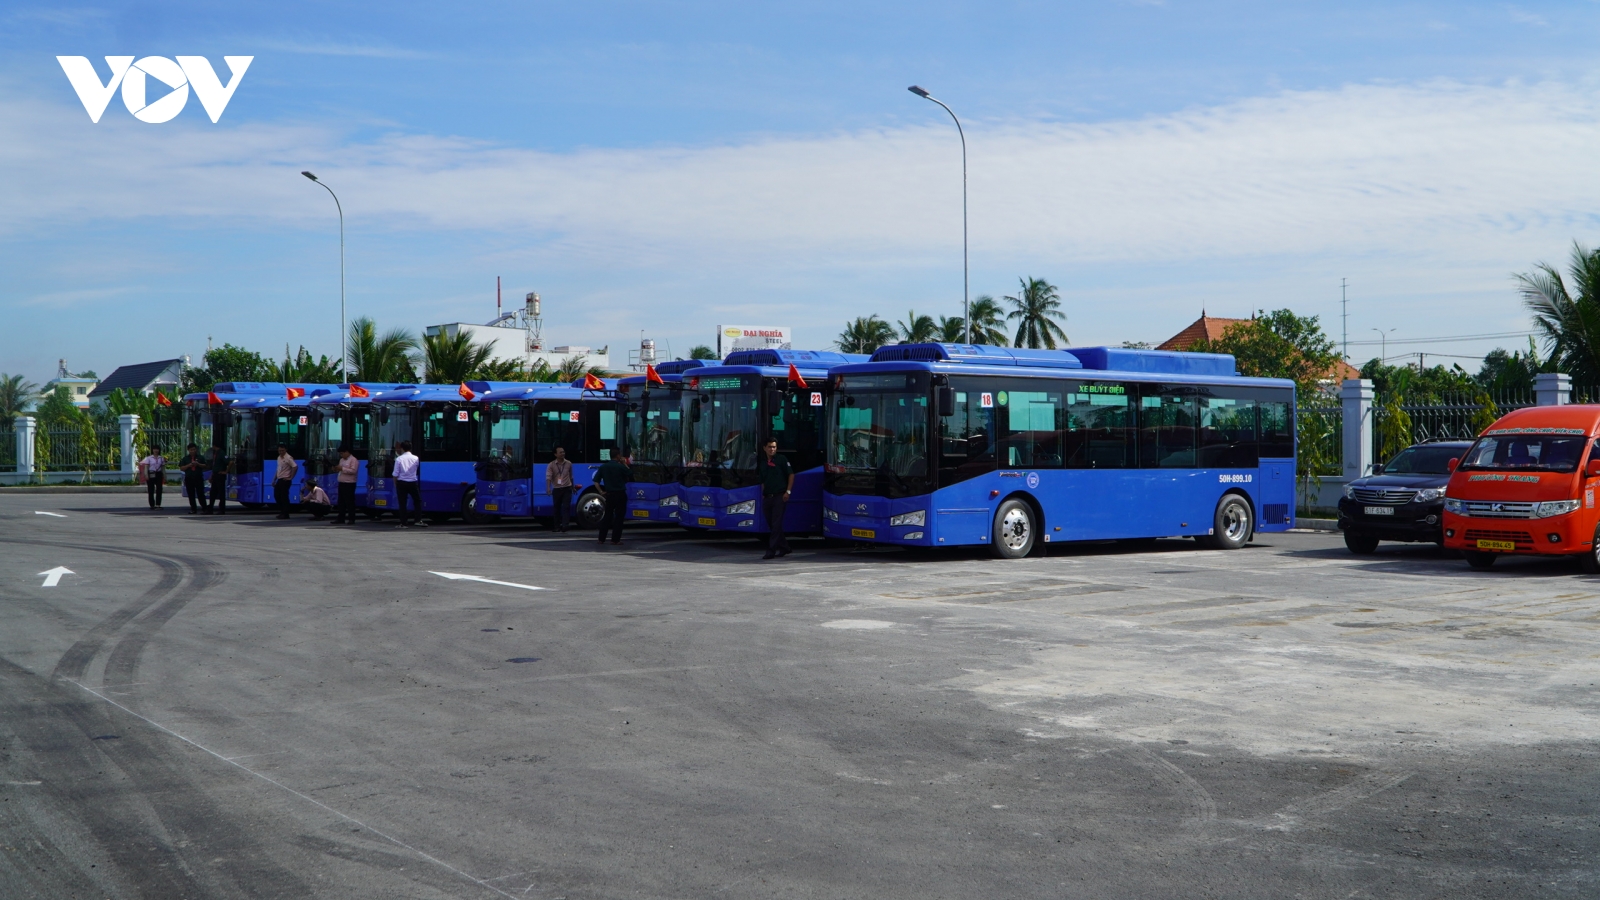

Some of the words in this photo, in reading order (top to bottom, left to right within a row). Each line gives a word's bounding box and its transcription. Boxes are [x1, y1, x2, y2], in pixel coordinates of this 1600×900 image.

[1089, 384, 1108, 393] BUÝT
[811, 394, 821, 404] 23
[982, 394, 992, 406] 18
[458, 412, 468, 420] 58
[570, 412, 580, 420] 58
[1218, 474, 1253, 483] 50H-899.10
